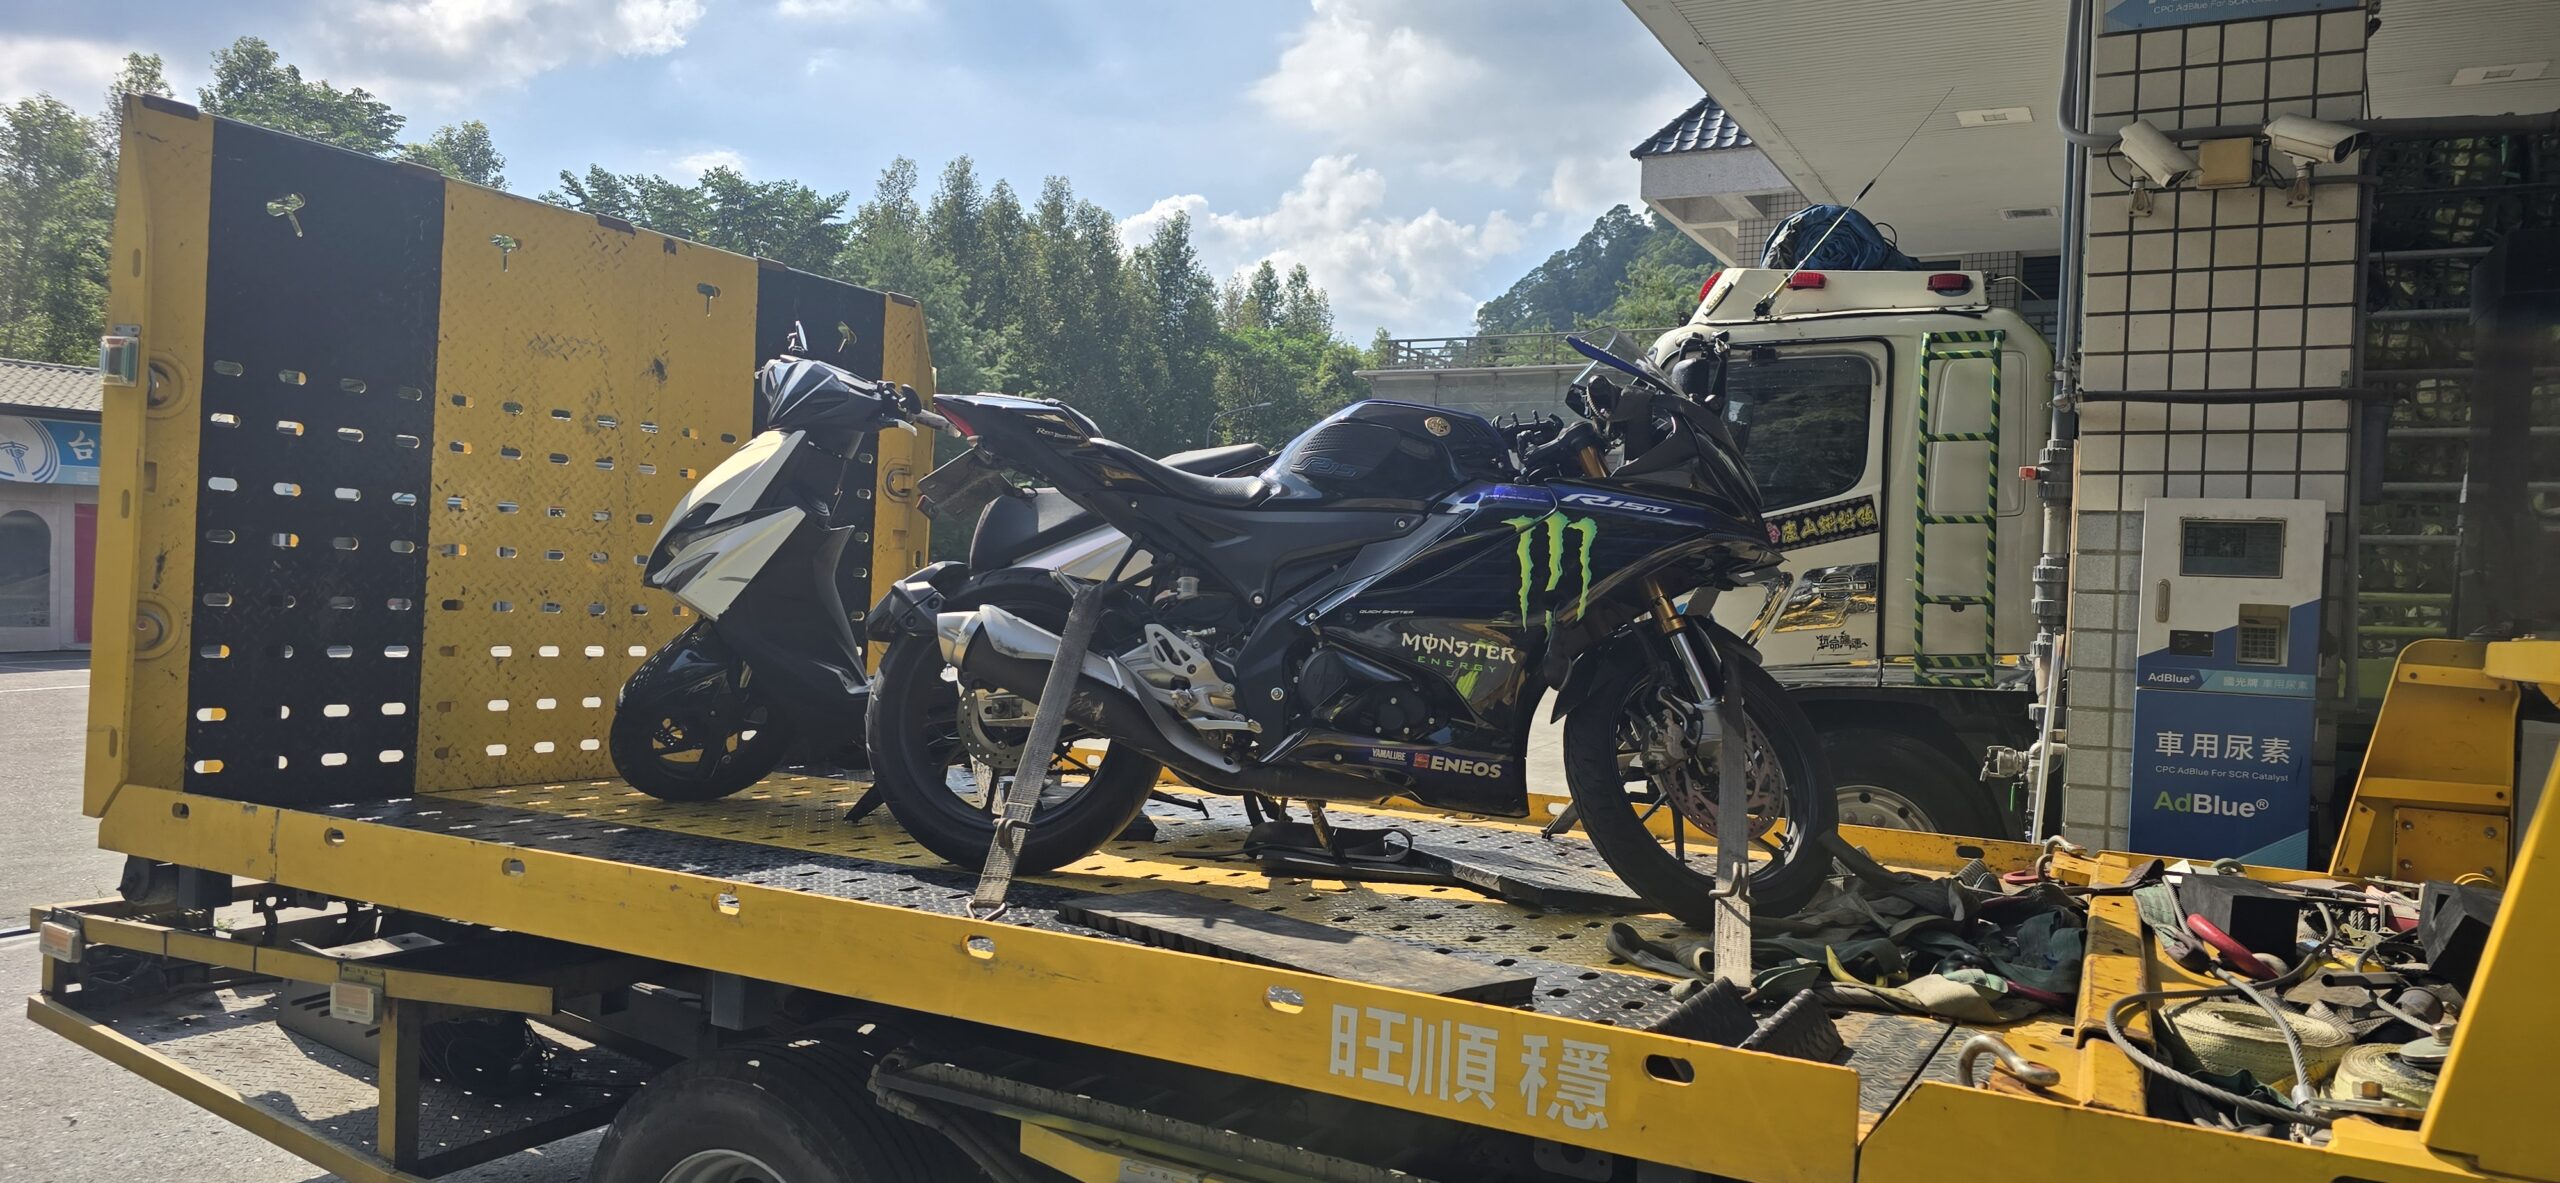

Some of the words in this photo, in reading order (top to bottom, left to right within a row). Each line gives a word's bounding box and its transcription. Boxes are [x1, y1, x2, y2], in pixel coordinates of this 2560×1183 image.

[2153, 5, 2174, 14] CPC
[2176, 2, 2208, 12] AdBlue
[2210, 0, 2226, 8] For
[68, 429, 96, 461] 台
[1417, 655, 1498, 674] ENERGY
[1372, 747, 1407, 761] YAMALUBE
[2155, 730, 2292, 765] 車用尿素
[1430, 755, 1503, 778] ENEOS
[2155, 765, 2176, 774] CPC
[2177, 766, 2210, 777] AdBlue
[2211, 768, 2227, 778] For
[2228, 770, 2250, 780] SCR
[2251, 772, 2289, 783] Catalyst
